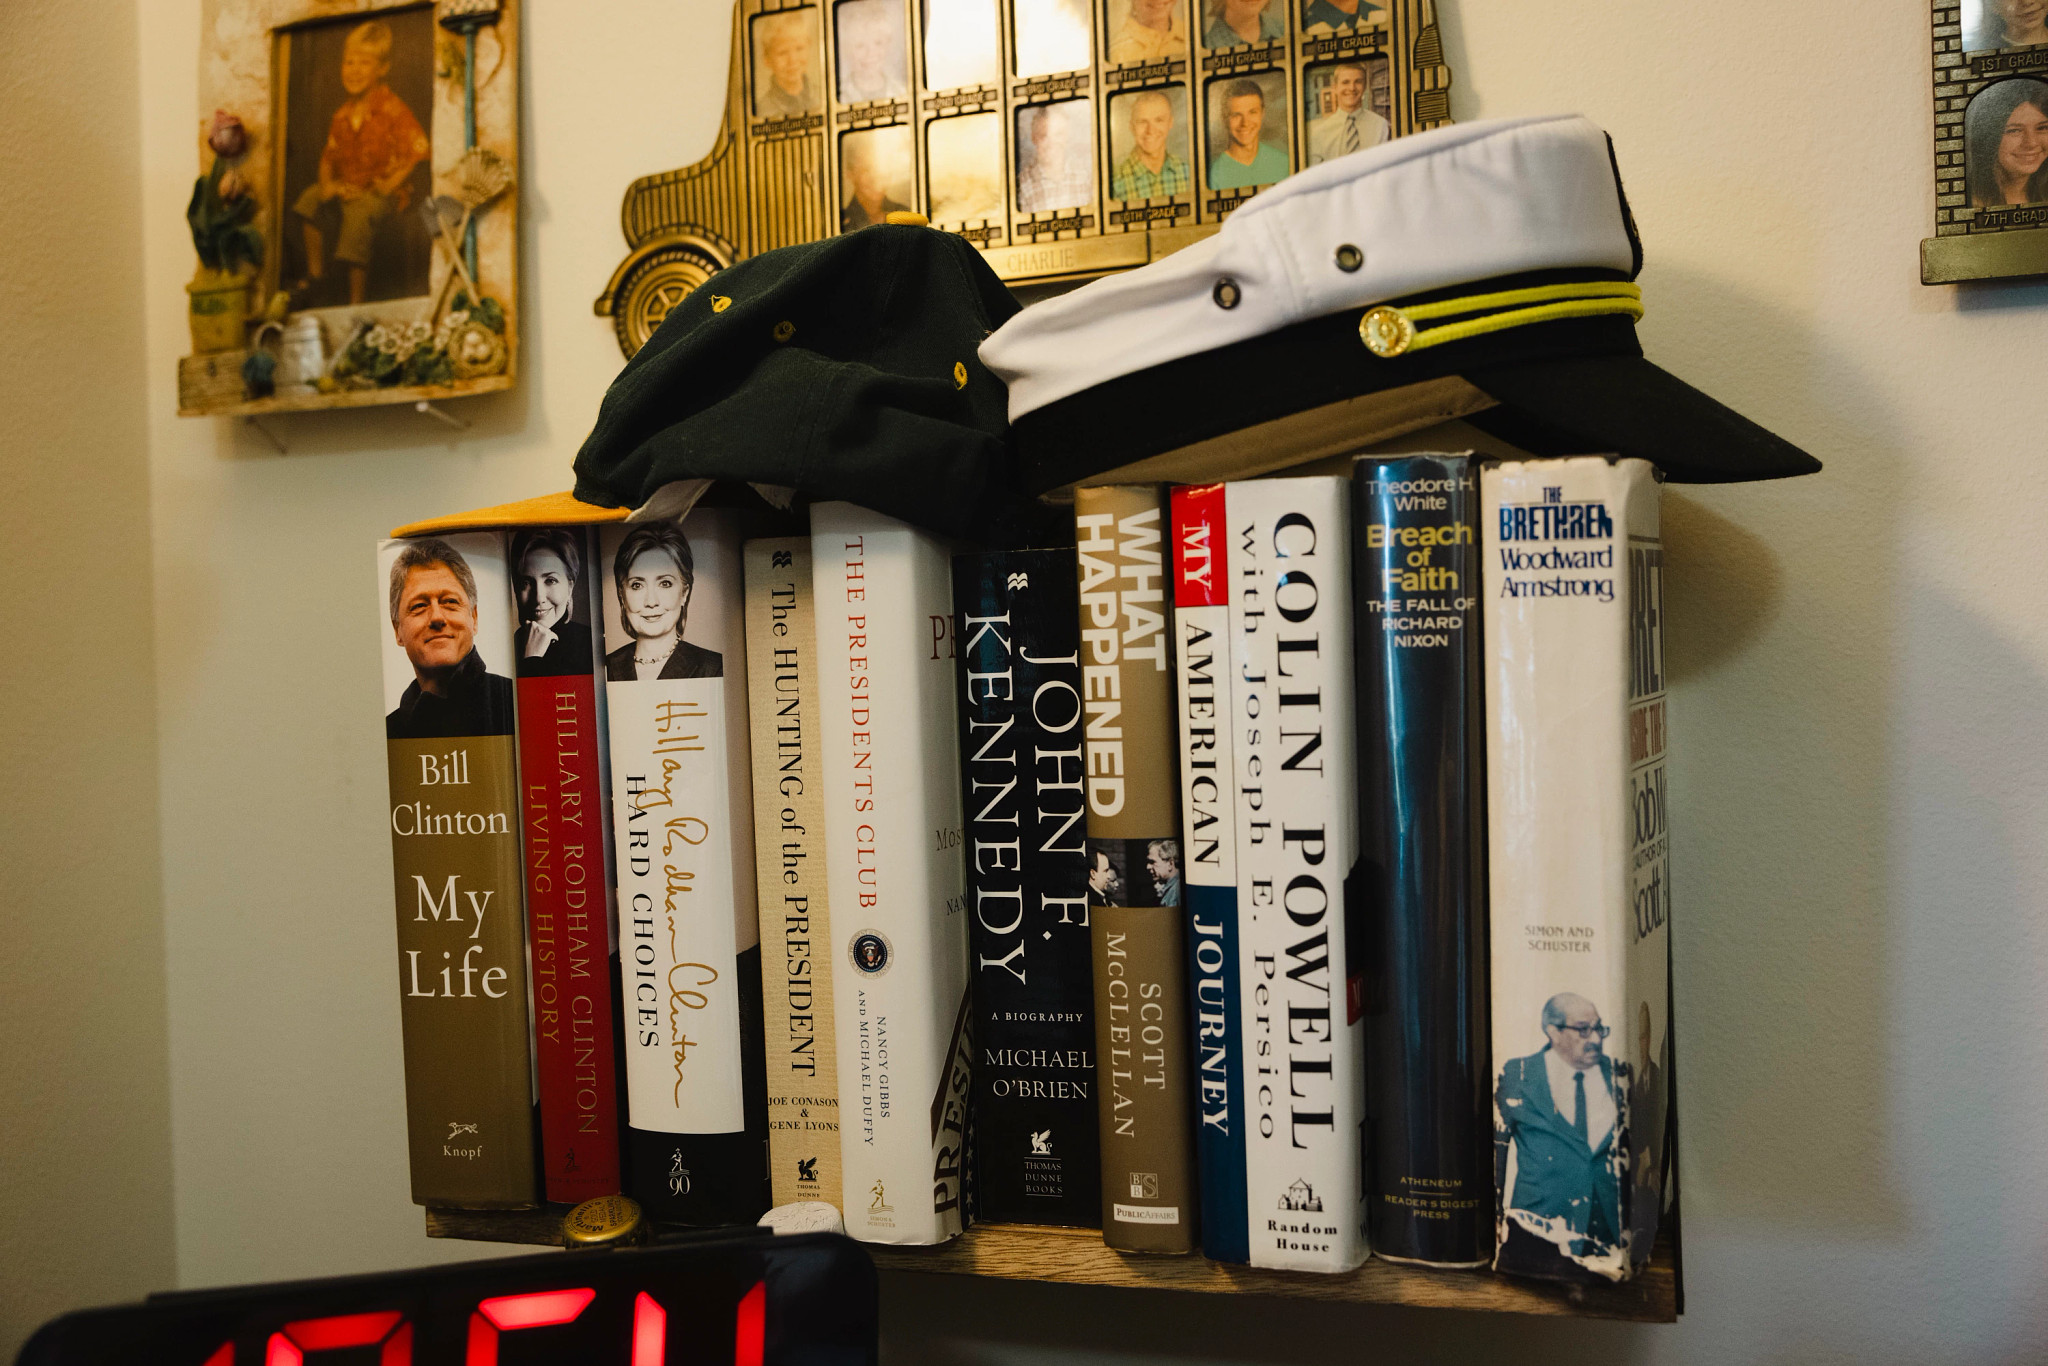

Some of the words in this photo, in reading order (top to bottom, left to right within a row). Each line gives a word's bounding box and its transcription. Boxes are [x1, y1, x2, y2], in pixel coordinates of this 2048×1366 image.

[1214, 56, 1234, 68] 5TH
[1236, 51, 1270, 65] GRADE
[1317, 40, 1337, 53] 6TH
[1342, 35, 1376, 49] GRADE
[1139, 65, 1169, 79] GRADE
[1980, 58, 2003, 72] 1ST
[1146, 207, 1177, 220] GRADE
[1983, 212, 2008, 226] 7TH
[1007, 248, 1074, 273] CHARLIE
[1366, 478, 1456, 495] Theodore
[1394, 496, 1447, 511] White
[1543, 486, 1563, 503] THE
[1366, 521, 1473, 548] Breach
[1500, 504, 1613, 541] BRETHREN
[845, 535, 865, 603] THE
[1182, 522, 1212, 590] MY
[1406, 547, 1432, 567] of
[1500, 545, 1613, 570] Woodward
[1118, 508, 1166, 671] WHAT
[1242, 521, 1266, 634] with
[1381, 567, 1459, 592] Faith
[1501, 576, 1615, 602] Armstrong
[771, 583, 797, 637] The
[1366, 600, 1401, 613] THE
[1406, 599, 1452, 612] FALL
[1454, 598, 1476, 611] OF
[1381, 616, 1463, 631] RICHARD
[1274, 512, 1323, 778] COLIN
[1394, 634, 1449, 648] NIXON
[1077, 513, 1125, 817] HAPPENED
[774, 647, 804, 798] HUNTING
[848, 614, 874, 812] PRESIDENTS
[555, 690, 583, 827] HILLARY
[635, 700, 708, 810] Hillary
[1019, 646, 1087, 858] JOHN
[1186, 620, 1220, 868] AMERICAN
[1241, 663, 1271, 847] Joseph
[418, 749, 471, 786] Bill
[964, 609, 1027, 985] KENNEDY
[392, 801, 510, 836] Clinton
[626, 773, 652, 877] HARD
[780, 807, 806, 835] of
[529, 784, 552, 894] LIVING
[782, 841, 808, 885] the
[856, 824, 877, 908] CLUB
[411, 875, 495, 939] My
[663, 816, 709, 964] Rodham
[1252, 875, 1274, 921] E.
[563, 843, 591, 980] RODHAM
[1041, 891, 1090, 940] F.
[1525, 925, 1564, 938] SIMON
[1567, 926, 1594, 939] AND
[1528, 940, 1591, 953] SCHUSTER
[405, 945, 508, 999] Life
[536, 913, 560, 1044] HISTORY
[632, 893, 660, 1047] CHOICES
[784, 894, 816, 1077] PRESIDENT
[1282, 822, 1335, 1149] POWELL
[858, 990, 866, 1016] AND
[992, 1012, 998, 1021] A
[1005, 1012, 1084, 1022] BIOGRAPHY
[668, 962, 719, 1108] Clinton
[877, 1016, 888, 1070] NANCY
[1140, 983, 1166, 1089] SCOTT
[1193, 914, 1229, 1136] JOURNEY
[860, 1021, 872, 1092] MICHAEL
[985, 1048, 1094, 1068] MICHAEL
[1254, 950, 1279, 1139] Persico
[571, 995, 599, 1134] CLINTON
[768, 1097, 788, 1107] JOE
[791, 1097, 839, 1108] CONASON
[879, 1074, 890, 1118] GIBBS
[993, 1079, 1088, 1099] O'BRIEN
[769, 1121, 801, 1130] GENE
[805, 1121, 839, 1132] LYONS
[800, 1108, 809, 1117] &
[862, 1096, 874, 1146] DUFFY
[443, 1145, 483, 1160] Knopf
[1024, 1162, 1062, 1171] THOMAS
[669, 1175, 691, 1197] 90
[1025, 1173, 1062, 1182] DUNNE
[1026, 1185, 1063, 1194] BOOKS
[1400, 1176, 1462, 1188] ATHENEUM
[574, 1202, 604, 1232] Martinelli's
[1384, 1194, 1438, 1208] READERS
[1440, 1200, 1480, 1208] DIGEST
[1413, 1209, 1450, 1219] PRESS
[1267, 1220, 1338, 1235] Random
[1276, 1238, 1330, 1252] House
